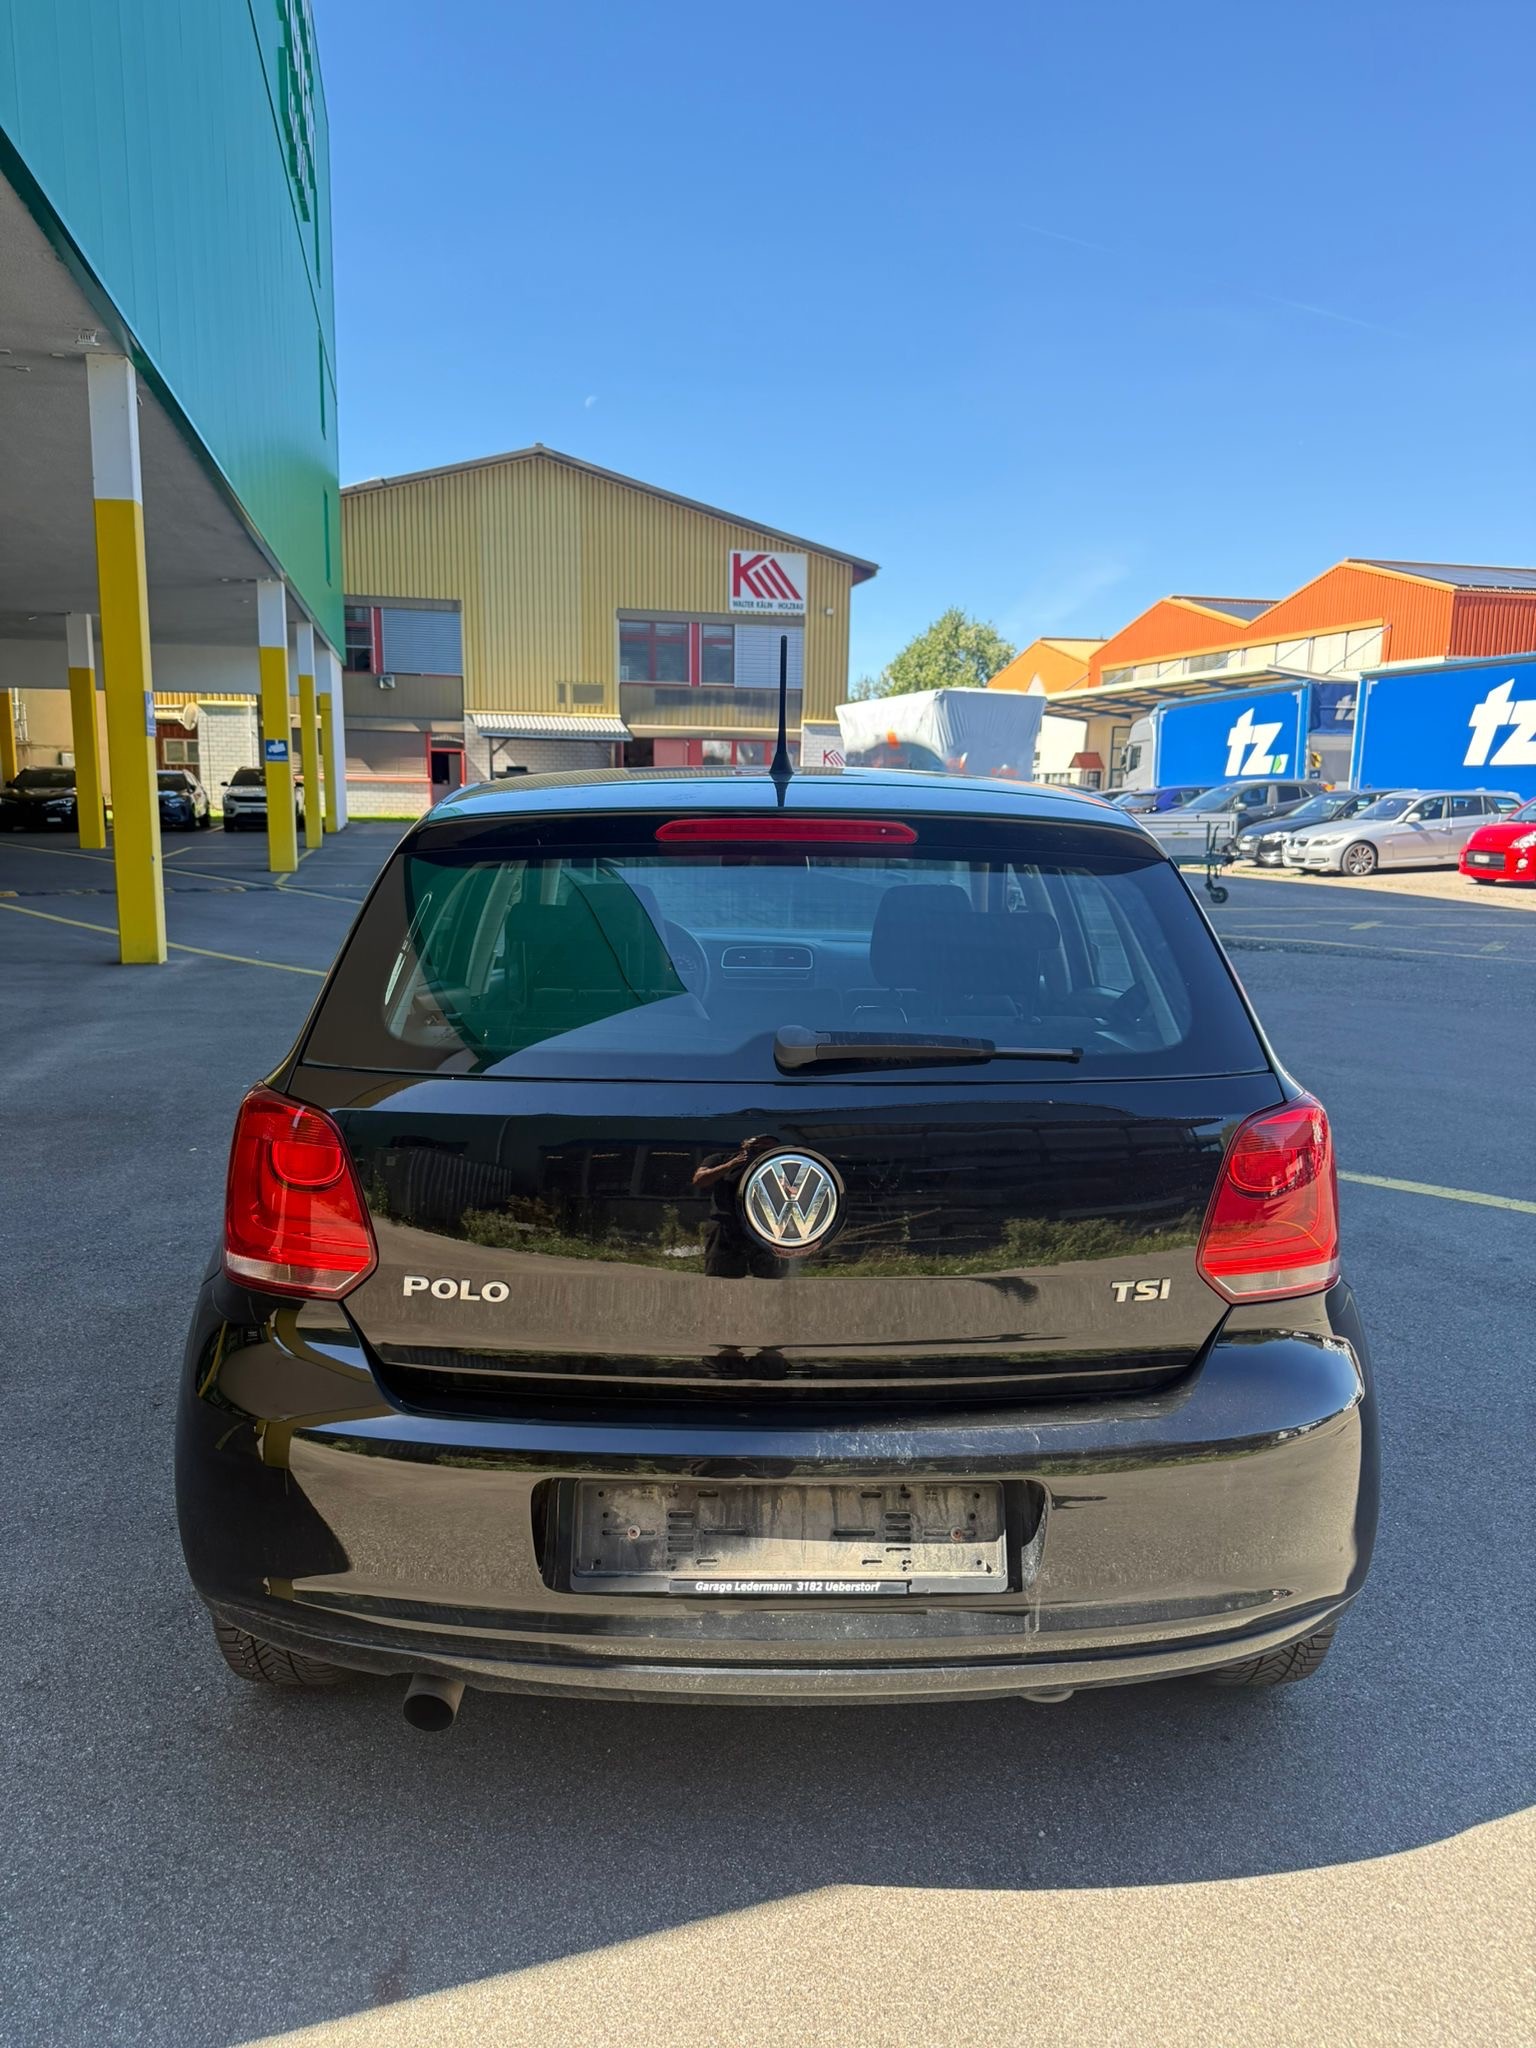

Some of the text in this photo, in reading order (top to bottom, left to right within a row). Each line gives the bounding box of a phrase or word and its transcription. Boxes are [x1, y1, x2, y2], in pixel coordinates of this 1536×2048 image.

[732, 600, 754, 608] WALTER
[777, 602, 804, 610] HOLZBAU
[403, 1275, 510, 1303] POLO
[1111, 1278, 1171, 1303] TSI
[695, 1582, 881, 1593] Garage Ledermann 3182 Ueberstorf
